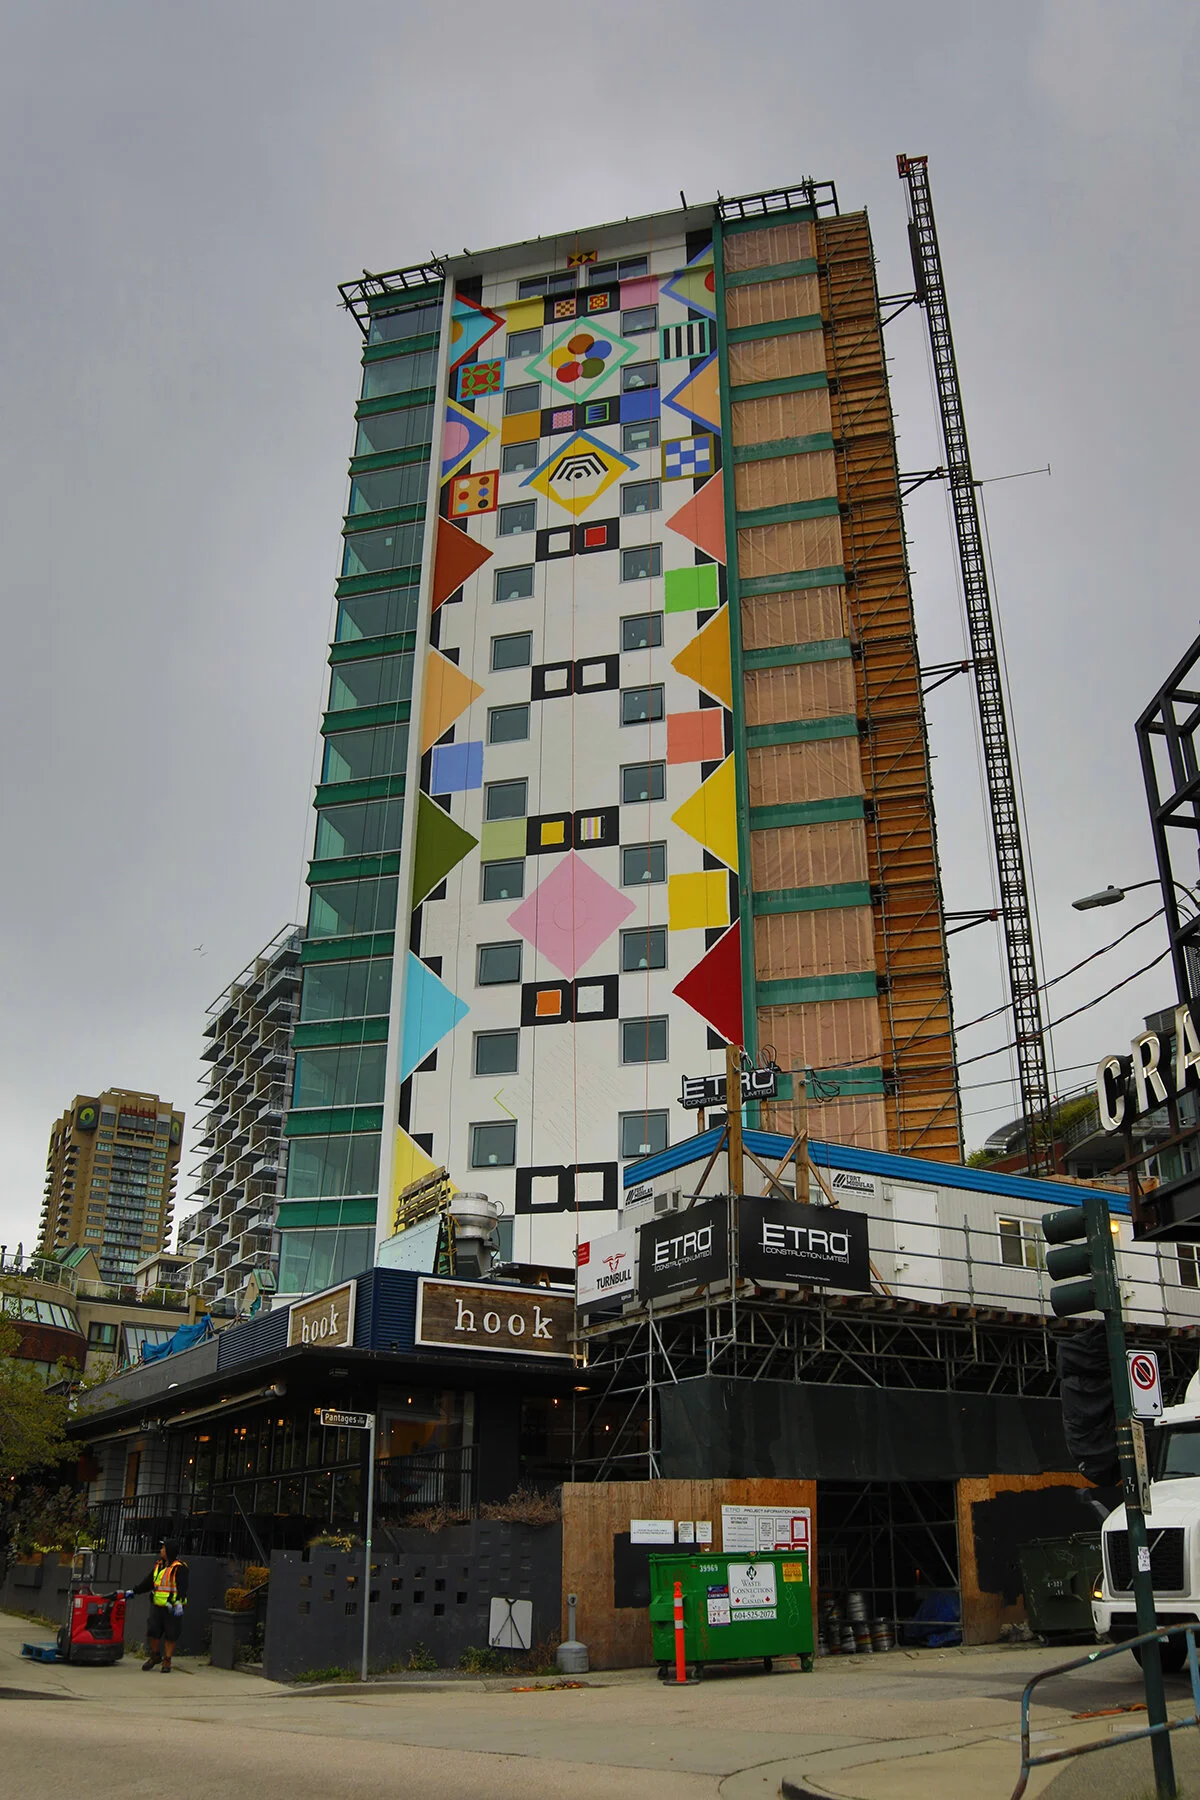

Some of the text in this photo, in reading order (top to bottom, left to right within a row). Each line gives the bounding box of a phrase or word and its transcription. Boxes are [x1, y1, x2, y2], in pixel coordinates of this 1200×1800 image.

[1096, 1003, 1200, 1131] CRA
[686, 1088, 773, 1106] CONSTRUC LIMITED
[655, 1226, 712, 1265] ETRO
[763, 1222, 849, 1256] ETRO
[656, 1250, 711, 1271] CONSTRUCTION LIMITED
[766, 1246, 847, 1263] CONSTRUCTION LIMITED
[596, 1269, 632, 1290] TURNBULL
[302, 1304, 340, 1344] hook
[454, 1299, 554, 1340] hook
[325, 1412, 357, 1425] Pantages
[732, 1586, 774, 1594] CONNECTIONS
[740, 1579, 761, 1587] WASTE
[734, 1610, 774, 1619] 604-525-2072
